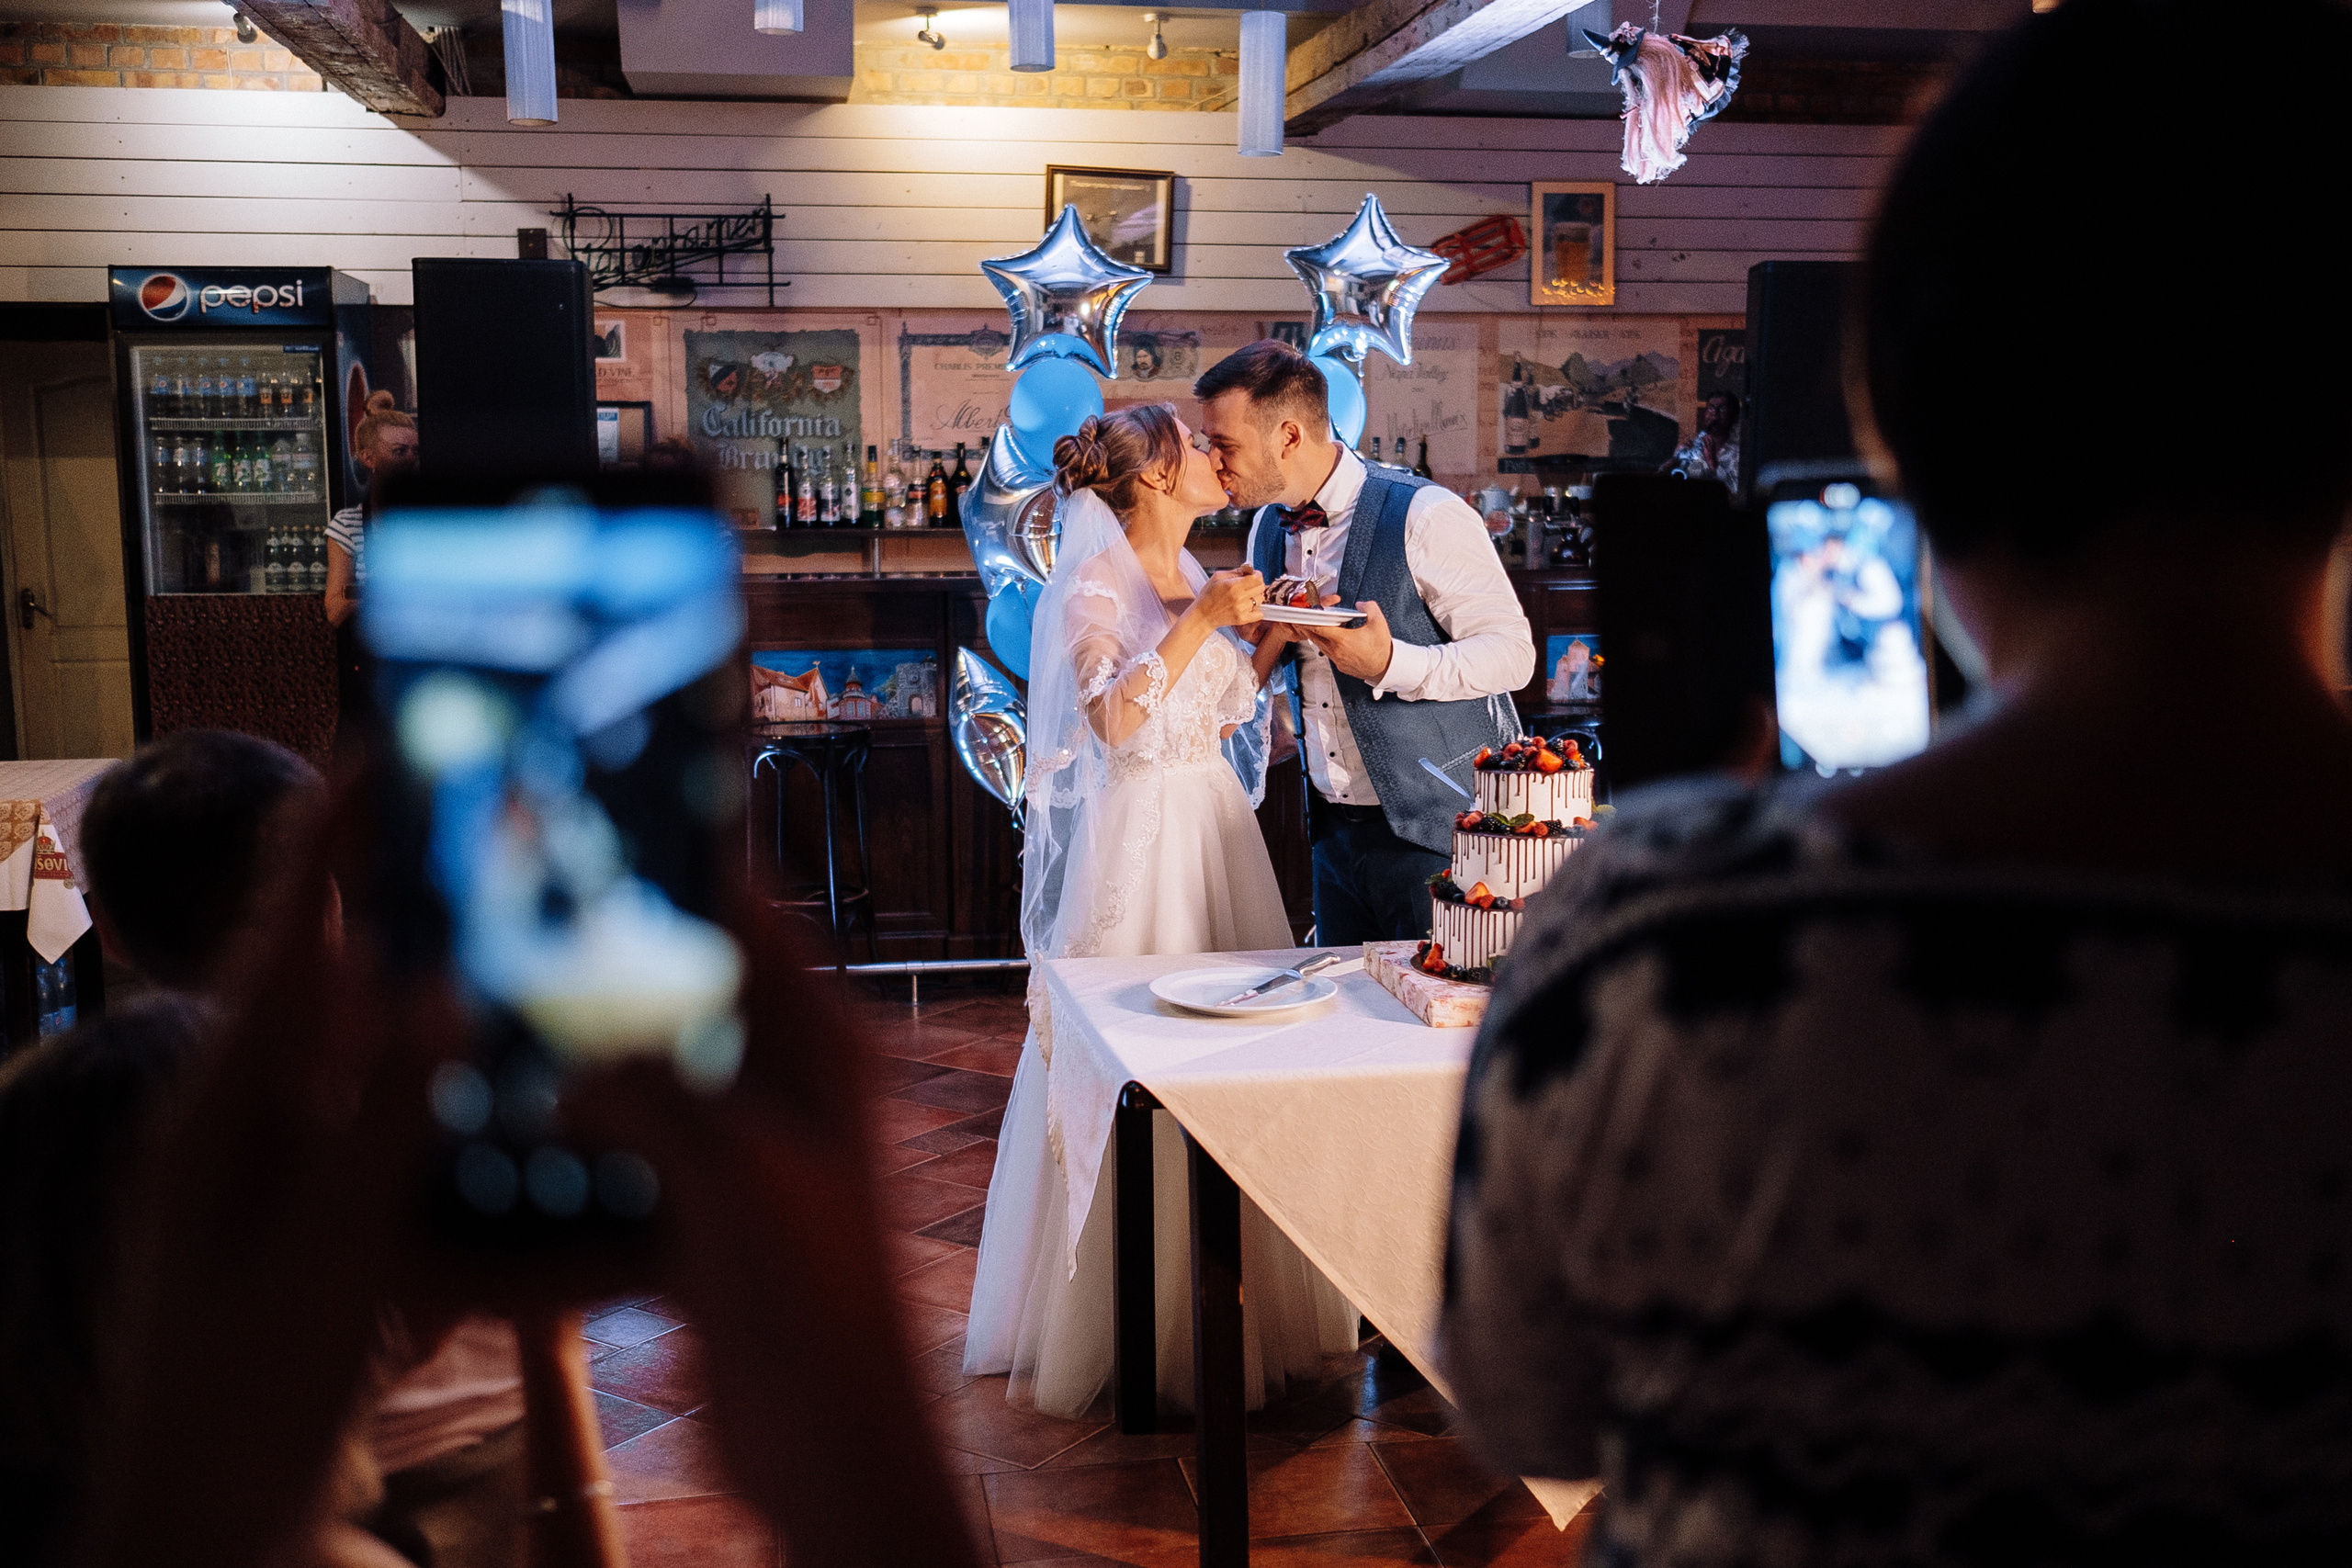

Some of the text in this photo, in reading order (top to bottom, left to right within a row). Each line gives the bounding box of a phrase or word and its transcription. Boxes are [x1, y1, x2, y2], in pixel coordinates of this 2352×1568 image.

[200, 279, 304, 314] pepsi
[702, 401, 842, 437] California
[35, 854, 69, 872] ŠOVI
